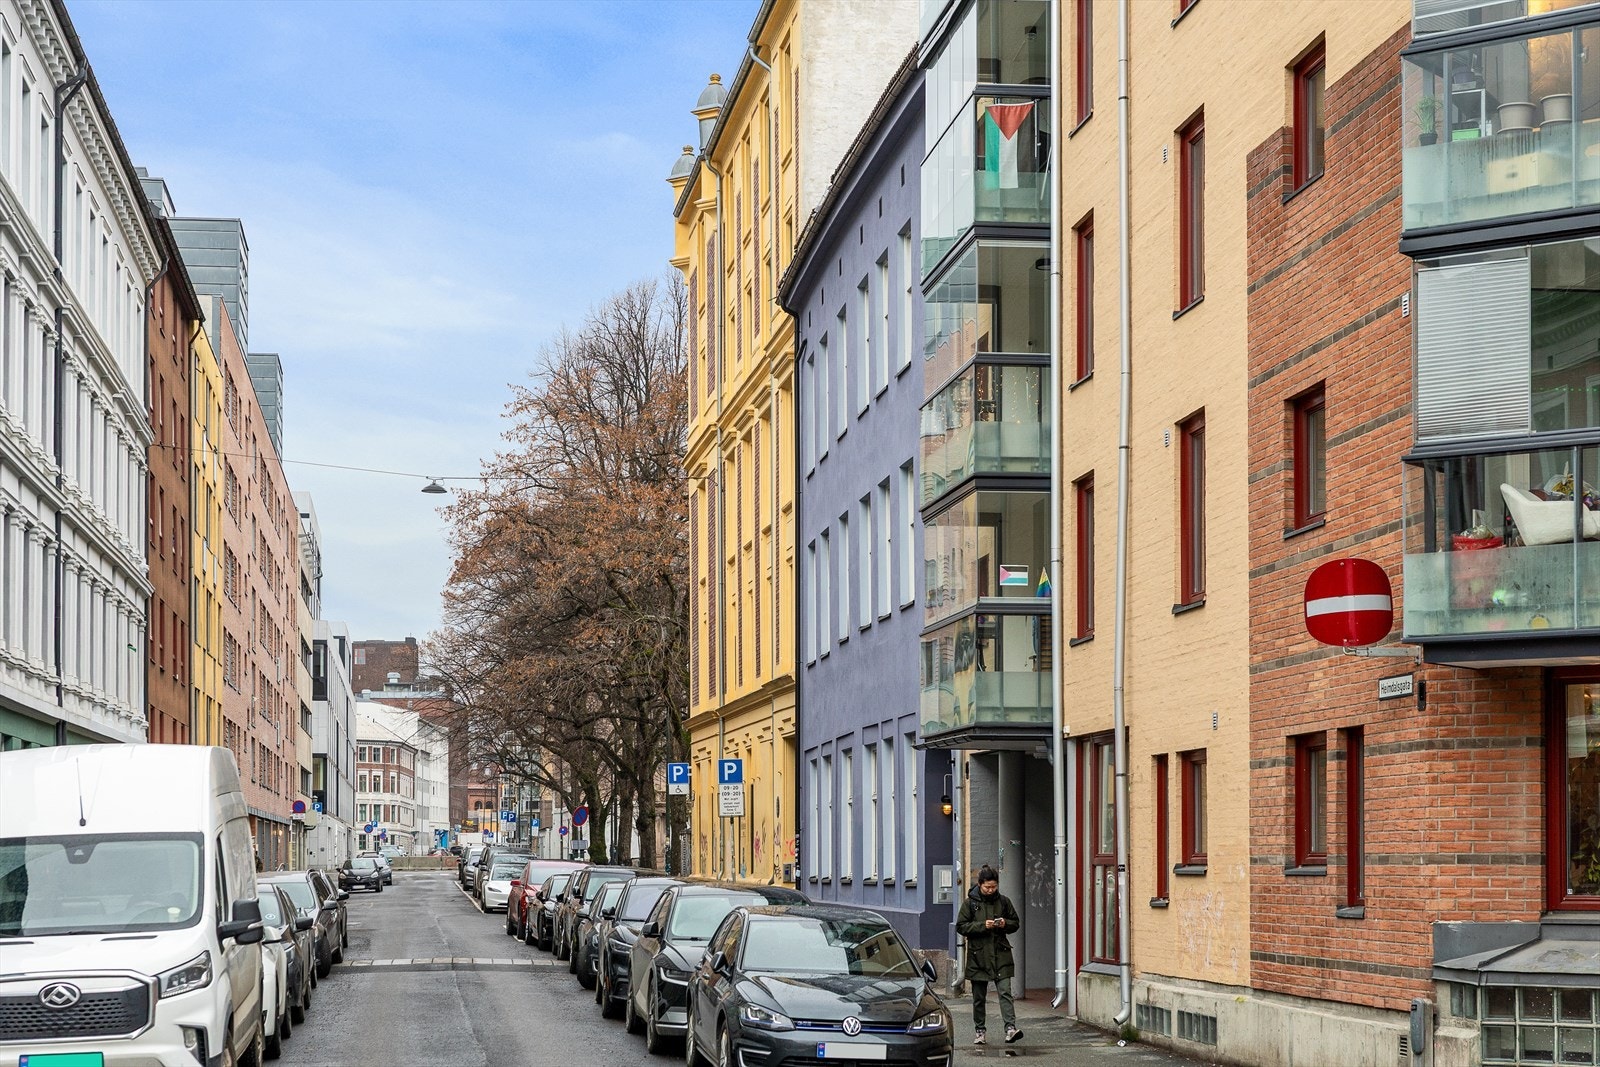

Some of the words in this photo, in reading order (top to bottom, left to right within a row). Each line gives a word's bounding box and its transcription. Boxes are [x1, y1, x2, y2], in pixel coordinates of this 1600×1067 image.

[1381, 681, 1411, 695] Heimdalsgata
[673, 765, 684, 782] P
[724, 762, 737, 781] P
[314, 803, 320, 811] P
[508, 813, 515, 822] P
